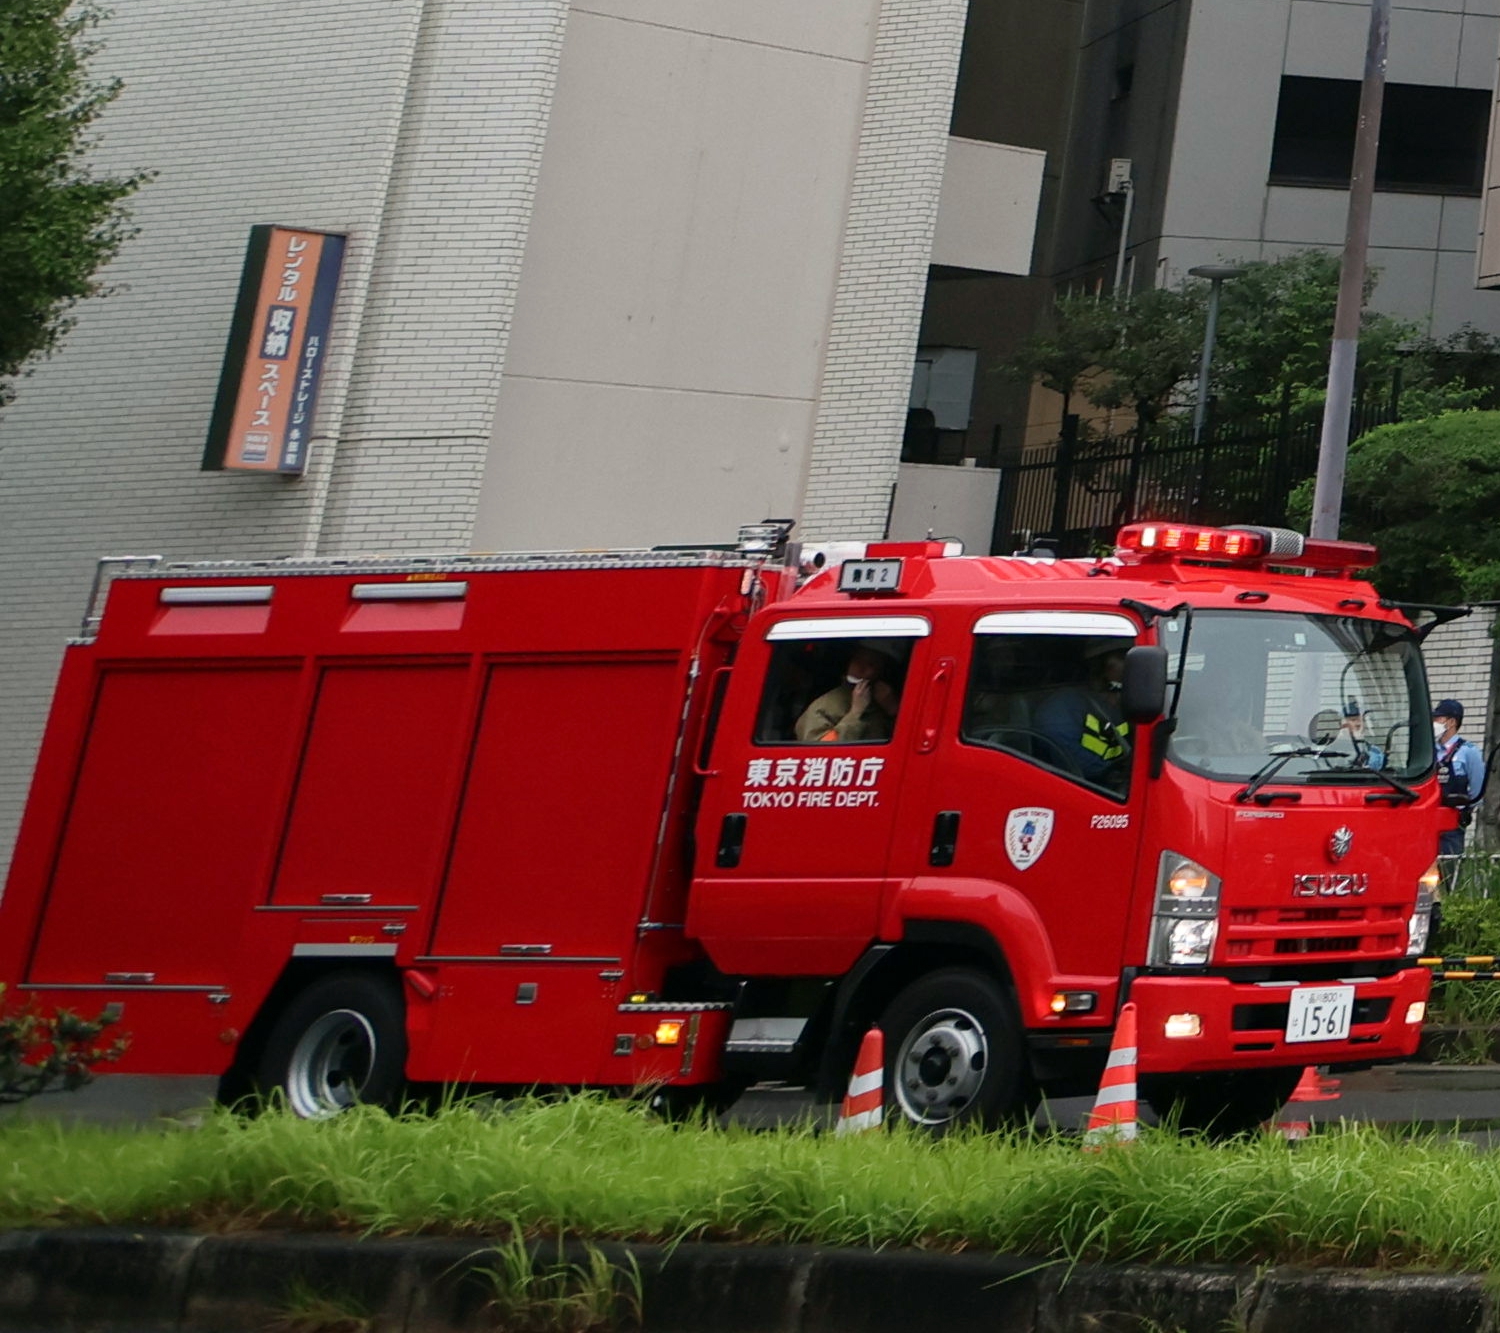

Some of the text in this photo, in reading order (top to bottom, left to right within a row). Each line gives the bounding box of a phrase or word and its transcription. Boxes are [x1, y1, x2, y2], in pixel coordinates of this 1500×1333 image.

[880, 567, 889, 583] 2
[744, 756, 885, 788] 東京消防庁
[742, 790, 880, 809] TOKYO FIRE DEPT.
[1090, 814, 1129, 829] P26095
[1293, 872, 1369, 897] ISUZU
